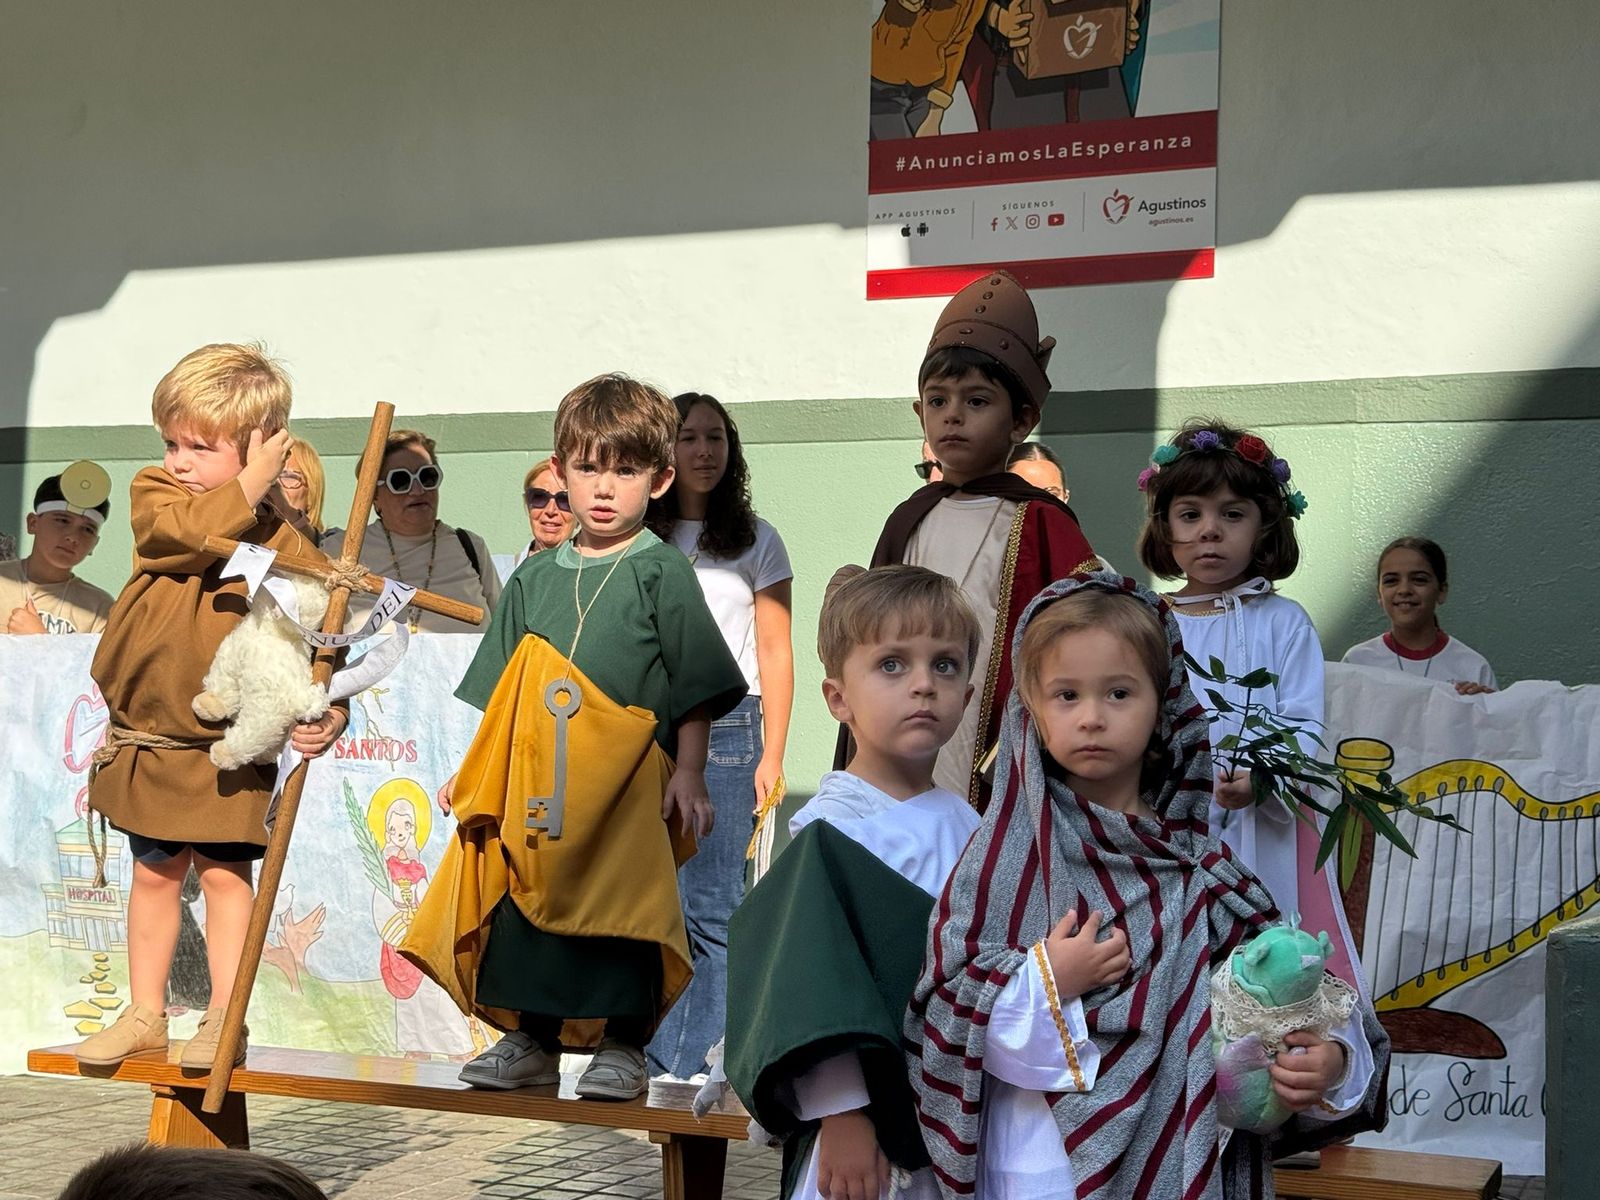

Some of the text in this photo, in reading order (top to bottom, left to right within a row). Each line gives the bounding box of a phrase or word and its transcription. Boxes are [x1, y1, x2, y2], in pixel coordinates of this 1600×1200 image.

[896, 135, 1193, 172] #AnunciamosLaEsperanza
[898, 208, 956, 218] AGUSTINOS
[1002, 201, 1055, 211] SÍGUENOS
[1138, 197, 1206, 215] Agustinos
[1148, 217, 1194, 227] agustinos.es
[334, 737, 418, 763] SANTOS
[68, 887, 116, 903] HOSPITAL
[1388, 1064, 1431, 1117] de
[1444, 1061, 1534, 1122] Santa
